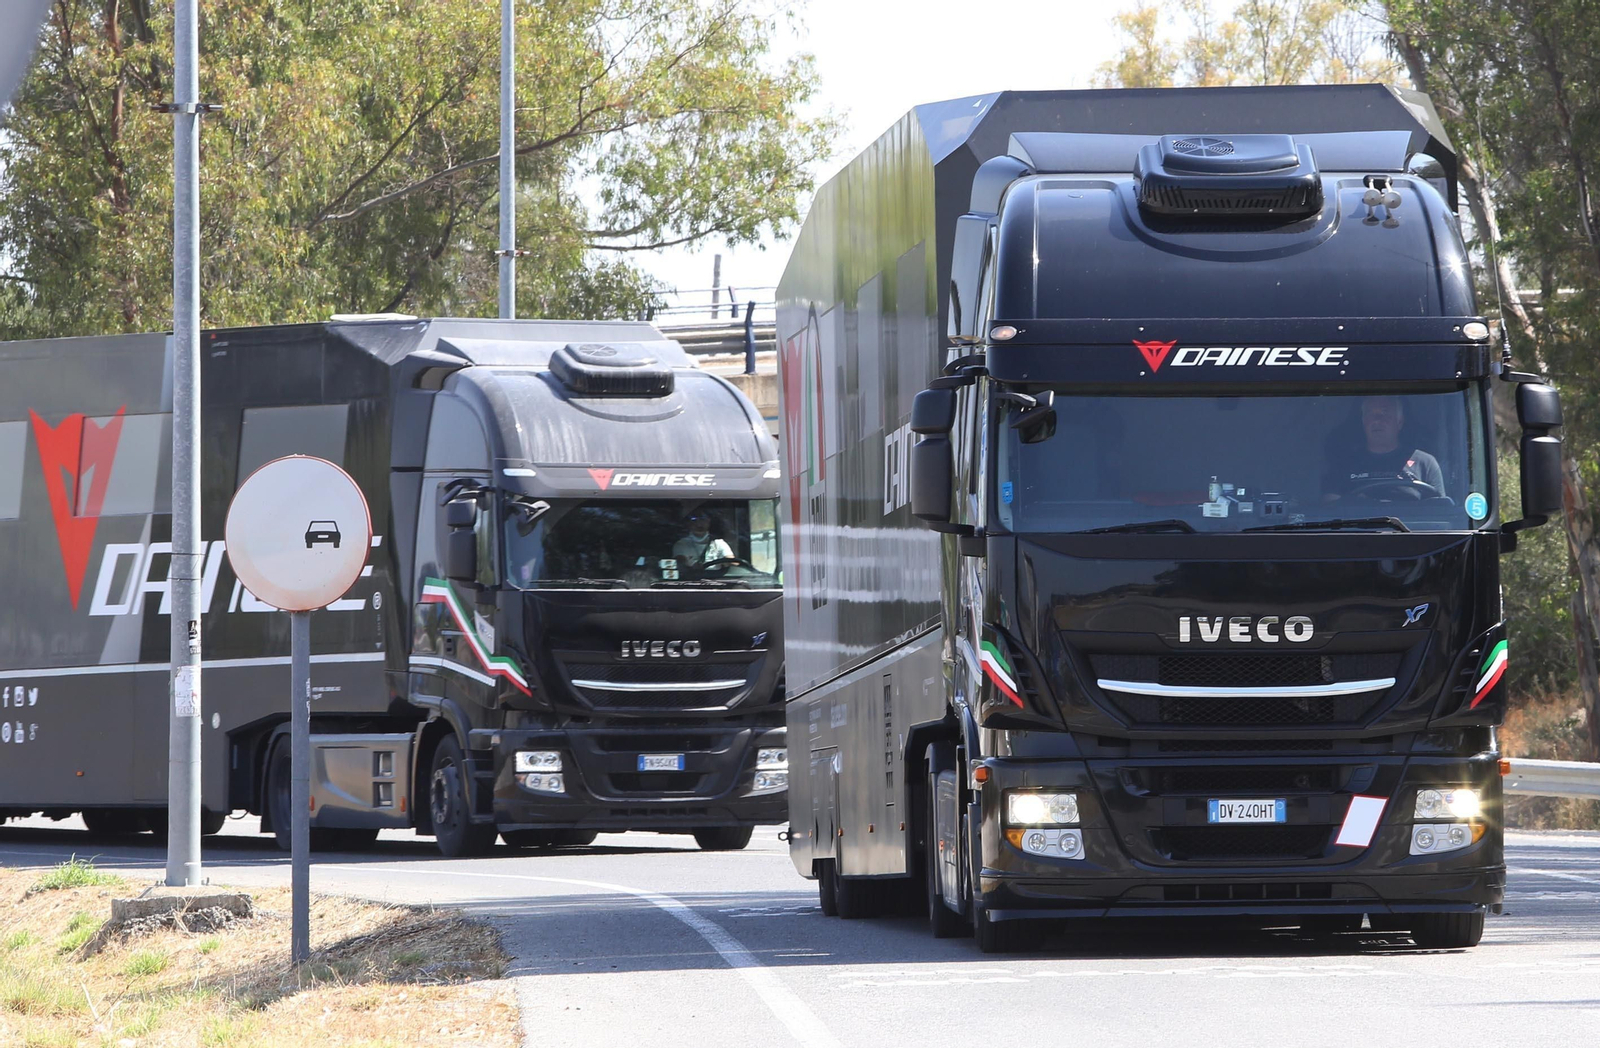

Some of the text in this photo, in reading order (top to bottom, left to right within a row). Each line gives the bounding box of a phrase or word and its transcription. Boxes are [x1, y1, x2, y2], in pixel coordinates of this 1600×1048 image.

[1170, 347, 1349, 366] DAINESE
[611, 473, 717, 486] DAINESE
[1472, 502, 1482, 516] 5
[1179, 616, 1314, 643] IVECO
[621, 640, 701, 658] IVECO
